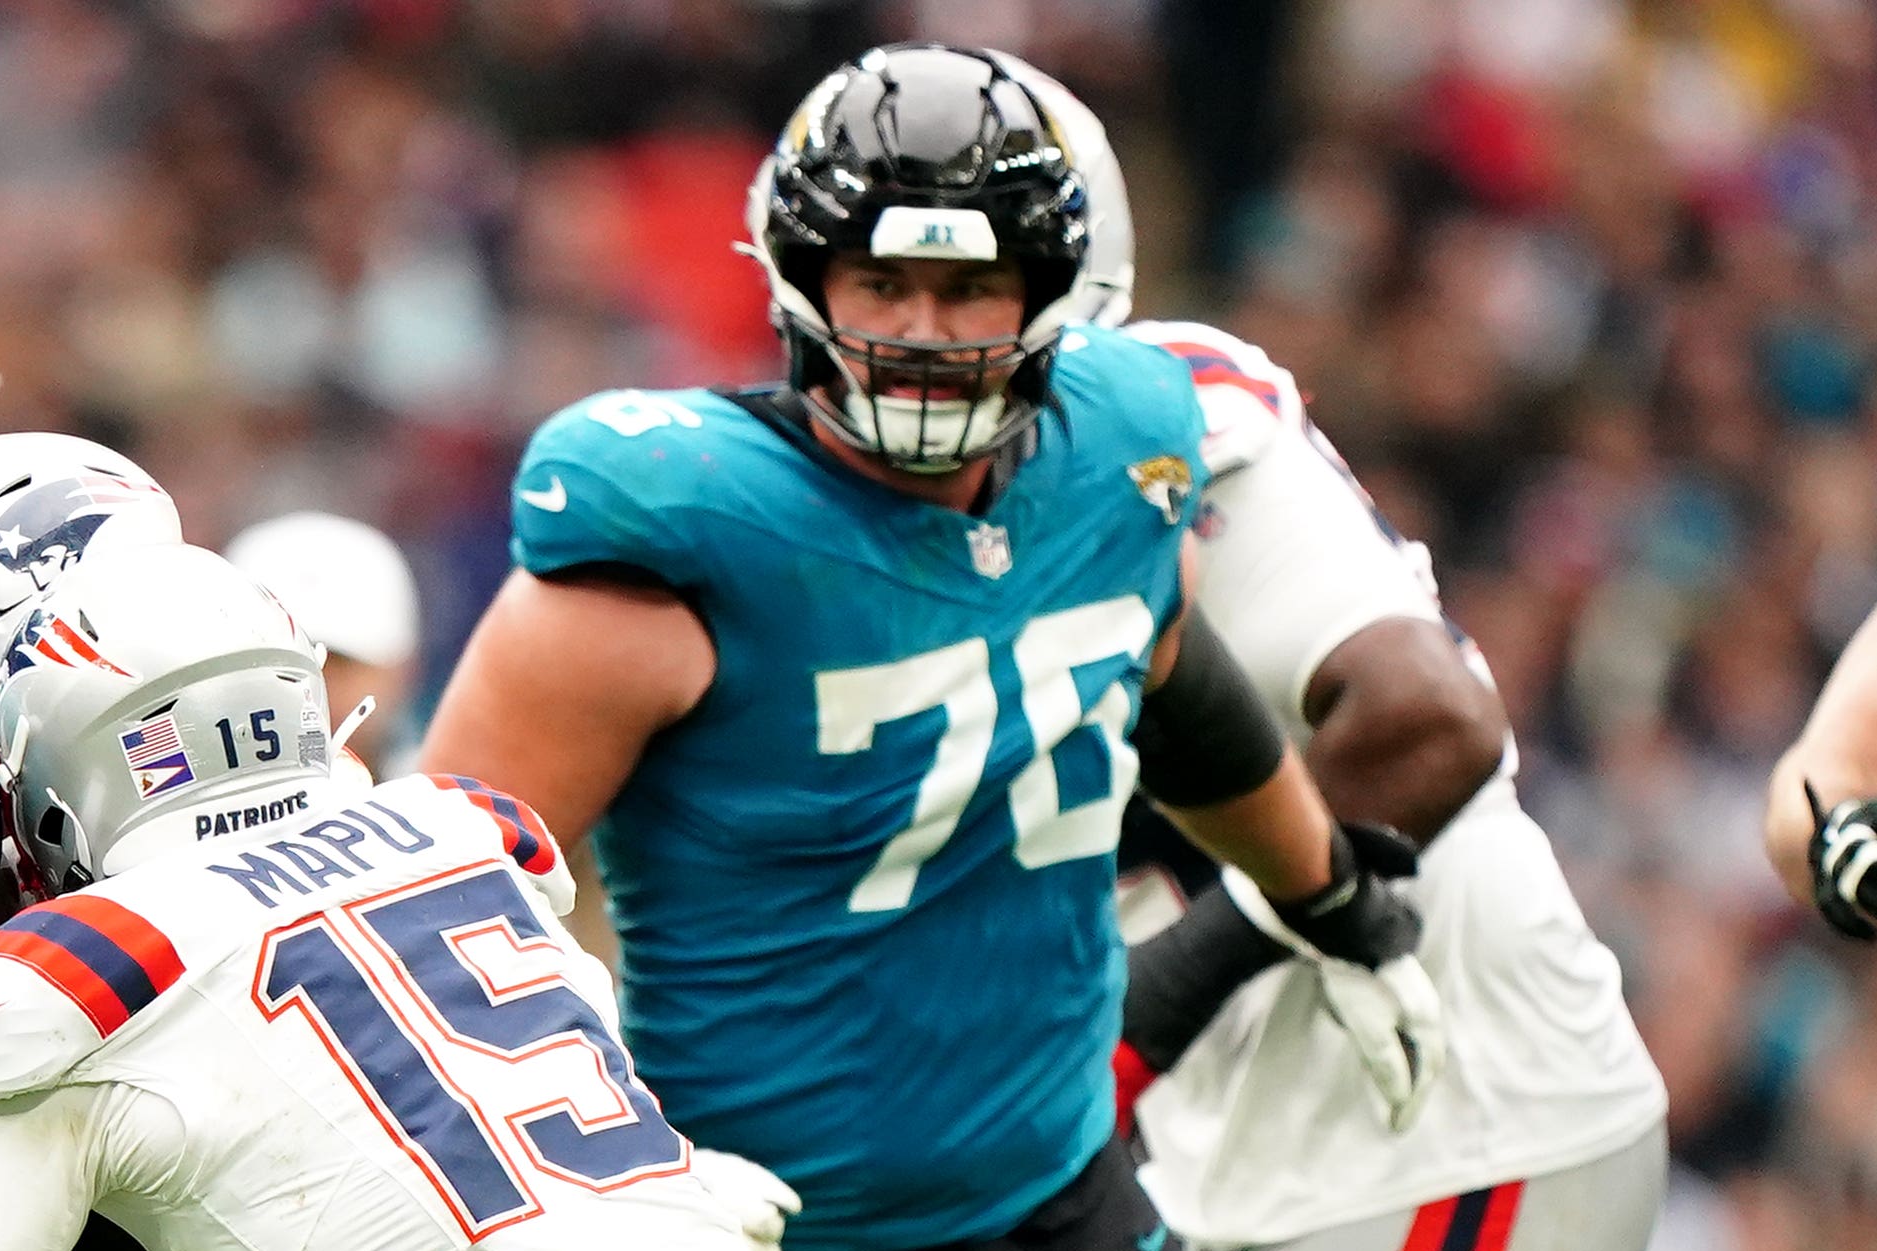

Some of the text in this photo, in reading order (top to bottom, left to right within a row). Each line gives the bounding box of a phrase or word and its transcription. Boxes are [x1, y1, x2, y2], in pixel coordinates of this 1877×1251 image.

[214, 709, 281, 769] 15
[814, 593, 1154, 913] 76
[205, 800, 435, 909] MAPU
[251, 858, 694, 1245] 15
